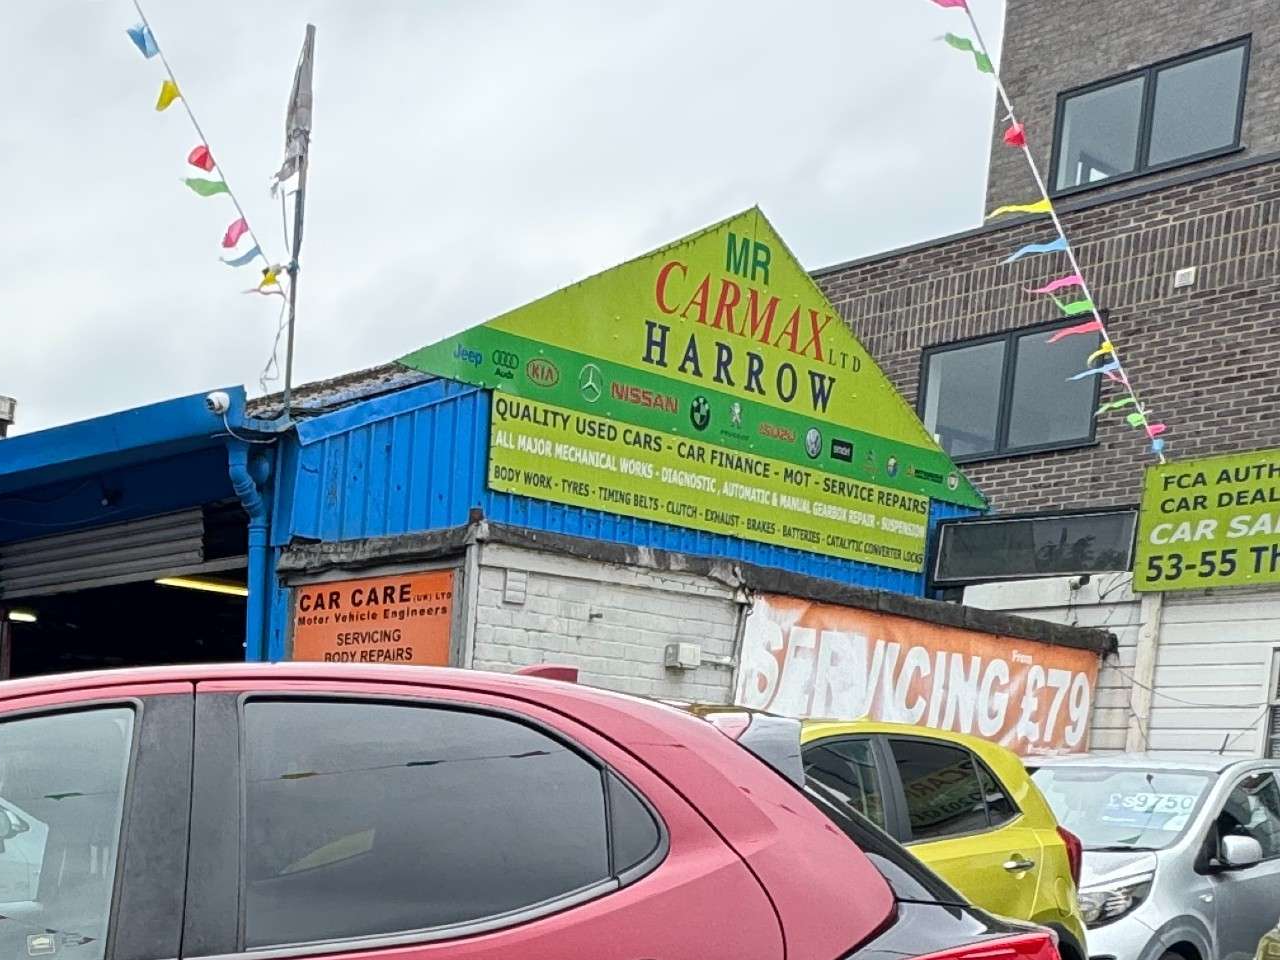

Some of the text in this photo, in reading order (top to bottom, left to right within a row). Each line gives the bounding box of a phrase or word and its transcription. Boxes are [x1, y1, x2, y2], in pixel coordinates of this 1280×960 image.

[726, 232, 771, 285] MR
[655, 261, 861, 373] CARMAX LTD
[454, 344, 482, 368] Jeep
[642, 320, 836, 414] HARROW
[531, 364, 554, 382] KIA
[611, 382, 679, 413] NISSAN
[496, 398, 927, 514] QUALITY USED CARS CAR FINANCE MOT SERVICE REPAIRS
[495, 430, 515, 449] ALL
[517, 436, 552, 457] MAJOR
[554, 443, 617, 471] MECHANICAL
[620, 456, 653, 480] WORKS
[661, 467, 716, 492] DIAGNOSTIC
[722, 481, 770, 505] AUTOMATIC
[780, 494, 811, 514] MANUAL
[1162, 463, 1280, 491] FCA AUTH
[494, 464, 520, 482] BODY
[523, 470, 552, 490] WORK
[561, 479, 590, 497] TYRES
[598, 486, 631, 506] TIMING
[633, 494, 658, 511] BELTS
[666, 500, 697, 518] CLUTCH
[704, 508, 740, 528] EXHAUST
[746, 518, 776, 535] BRAKES
[782, 525, 820, 544] BATTERIES
[826, 534, 863, 553] CATALYTIC
[864, 542, 901, 560] CONVERTER
[1160, 487, 1280, 513] CAR DEAL
[1149, 519, 1218, 545] CAR
[1145, 548, 1238, 582] 53-55
[299, 590, 341, 612] CAR
[351, 583, 412, 608] CARE
[435, 591, 452, 600] LTD
[298, 605, 448, 626] Motor Vehicle Engineers
[336, 628, 402, 647] SERVICING
[324, 646, 413, 662] BODY REPAIRS
[1017, 664, 1090, 746] £79
